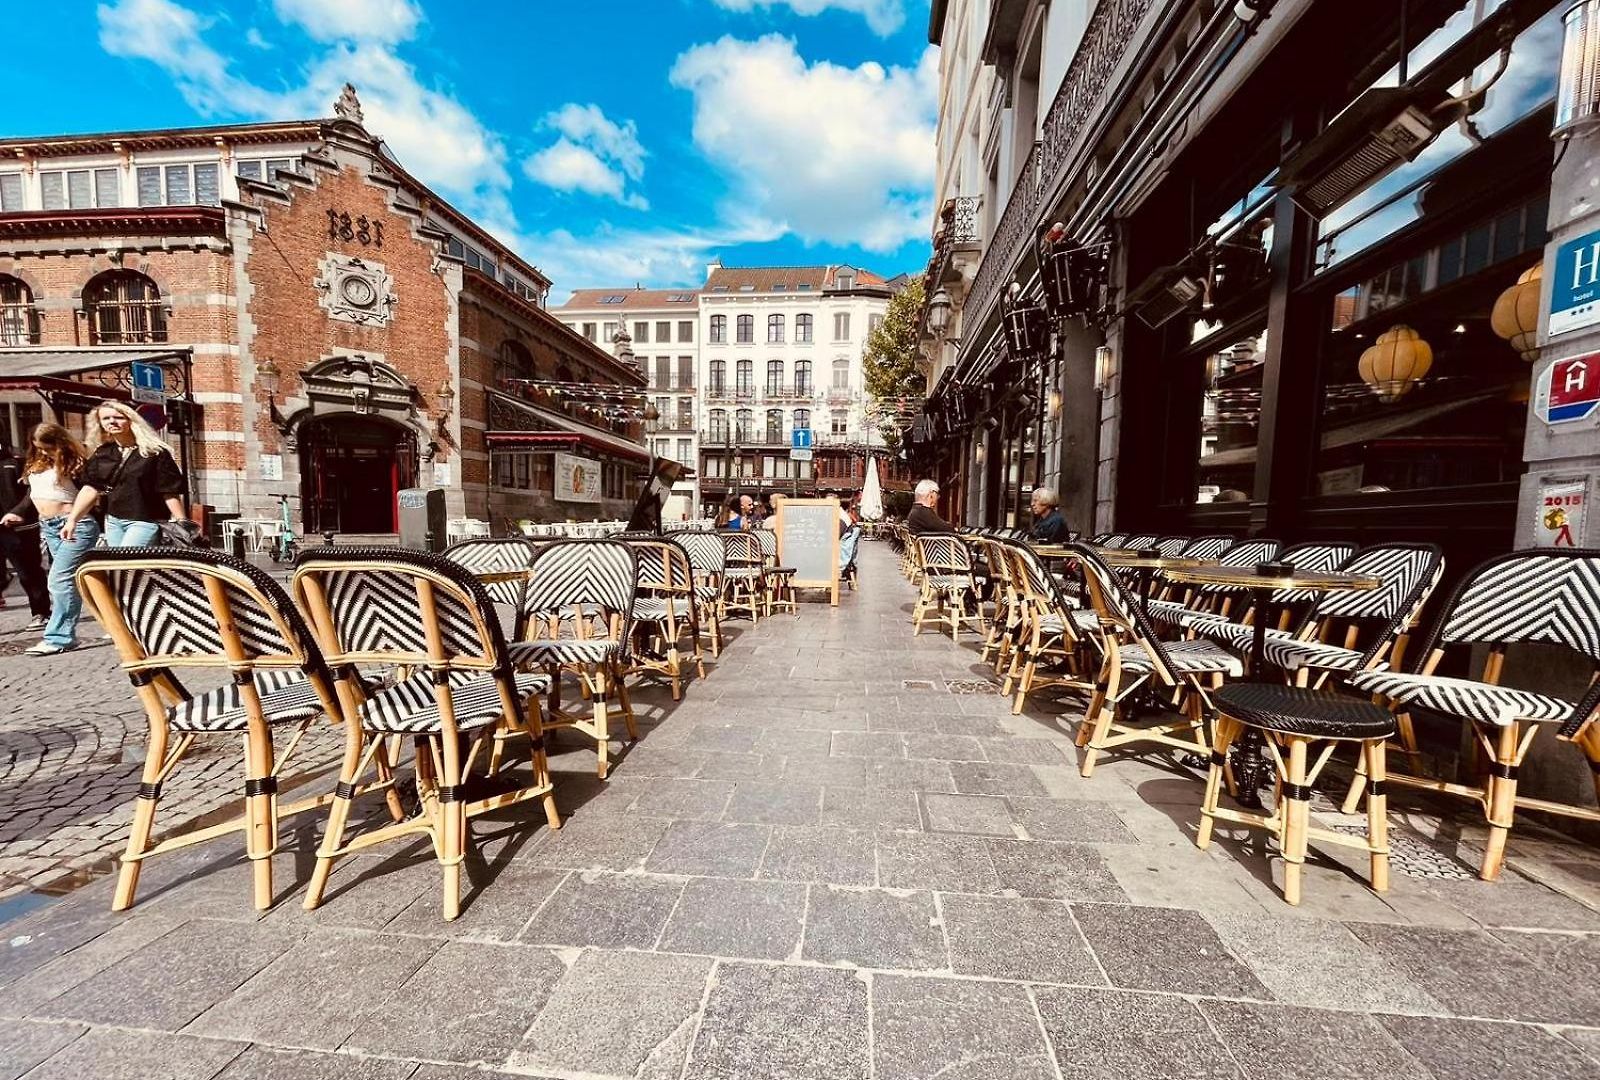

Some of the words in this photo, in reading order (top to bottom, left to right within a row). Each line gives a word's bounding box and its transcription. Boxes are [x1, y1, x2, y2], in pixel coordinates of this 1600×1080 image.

[326, 209, 384, 248] 1881
[1571, 241, 1600, 291] H
[1544, 494, 1582, 507] 2015
